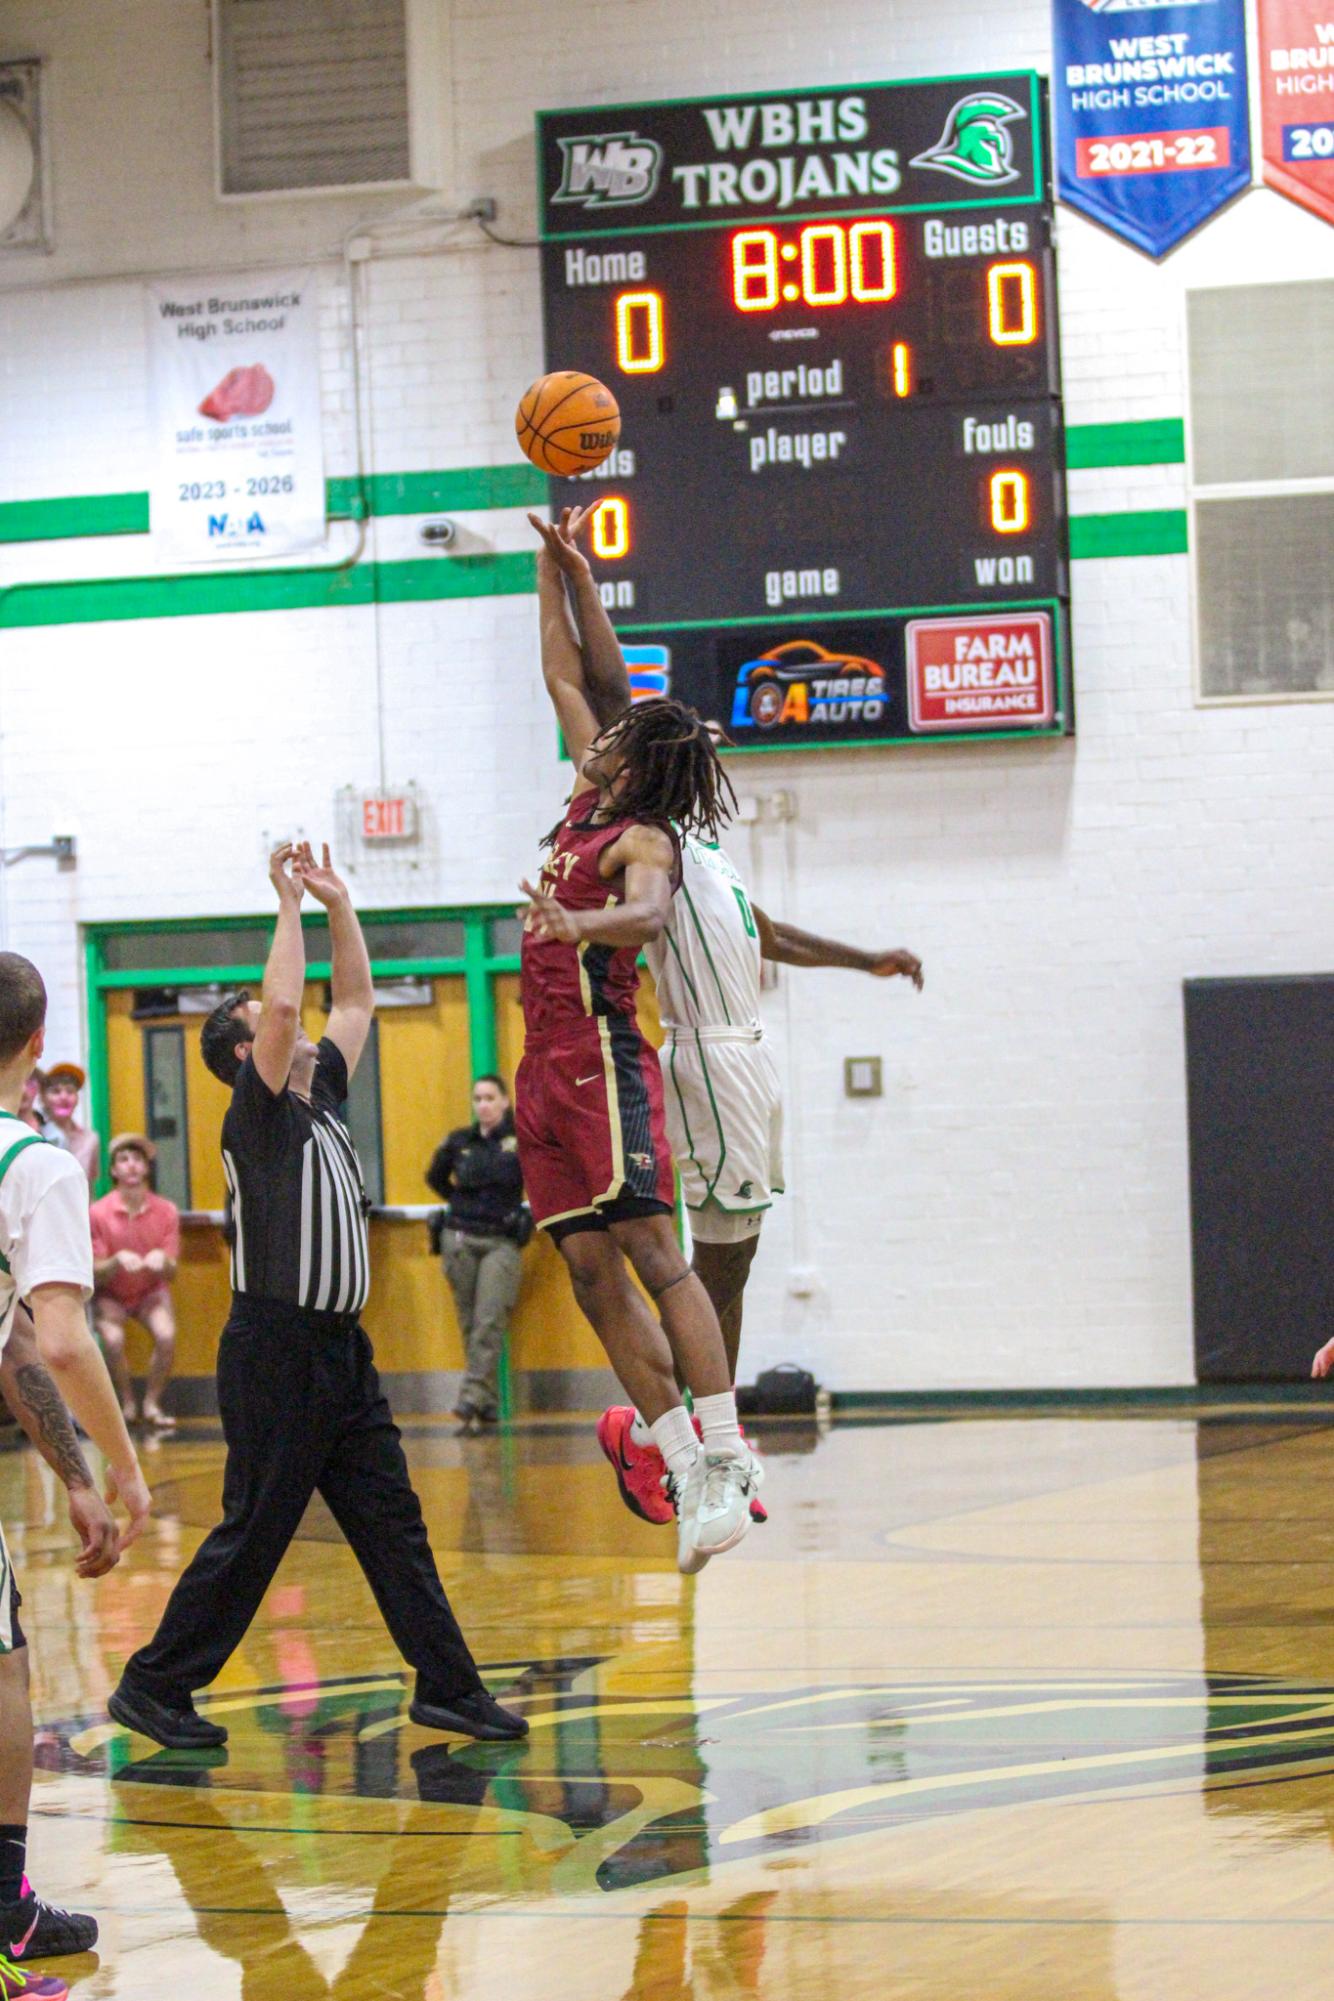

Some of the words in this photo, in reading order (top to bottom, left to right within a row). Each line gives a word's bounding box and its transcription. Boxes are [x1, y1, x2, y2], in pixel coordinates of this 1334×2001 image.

[1109, 34, 1187, 58] WEST
[1066, 54, 1234, 86] BRUNSWICK
[1071, 90, 1130, 110] HIGH
[1135, 82, 1230, 106] SCHOOL
[703, 97, 868, 150] WBHS
[1089, 137, 1217, 171] 2021-22
[1290, 127, 1334, 157] 20
[560, 135, 659, 203] WB
[672, 149, 901, 209] TROJANS
[924, 217, 1029, 258] Guests
[565, 248, 647, 286] Home
[732, 221, 897, 312] 8:00
[160, 302, 203, 318] West
[207, 293, 301, 314] Brunswick
[987, 263, 1036, 345] 0
[177, 322, 217, 341] High
[223, 317, 285, 335] School
[615, 291, 665, 374] 0
[747, 359, 842, 407] period
[750, 428, 846, 473] player
[963, 416, 1034, 454] fouls
[179, 480, 225, 502] 2023
[246, 475, 293, 496] 2026
[990, 471, 1028, 533] 0
[592, 497, 629, 559] 0
[765, 568, 840, 606] game
[975, 555, 1034, 586] won
[599, 580, 634, 609] on
[953, 634, 1033, 662] FARM
[924, 658, 1036, 691] BUREAU
[809, 700, 883, 723] AUTO
[945, 694, 1037, 714] INSURANCE
[362, 799, 406, 835] EXIT
